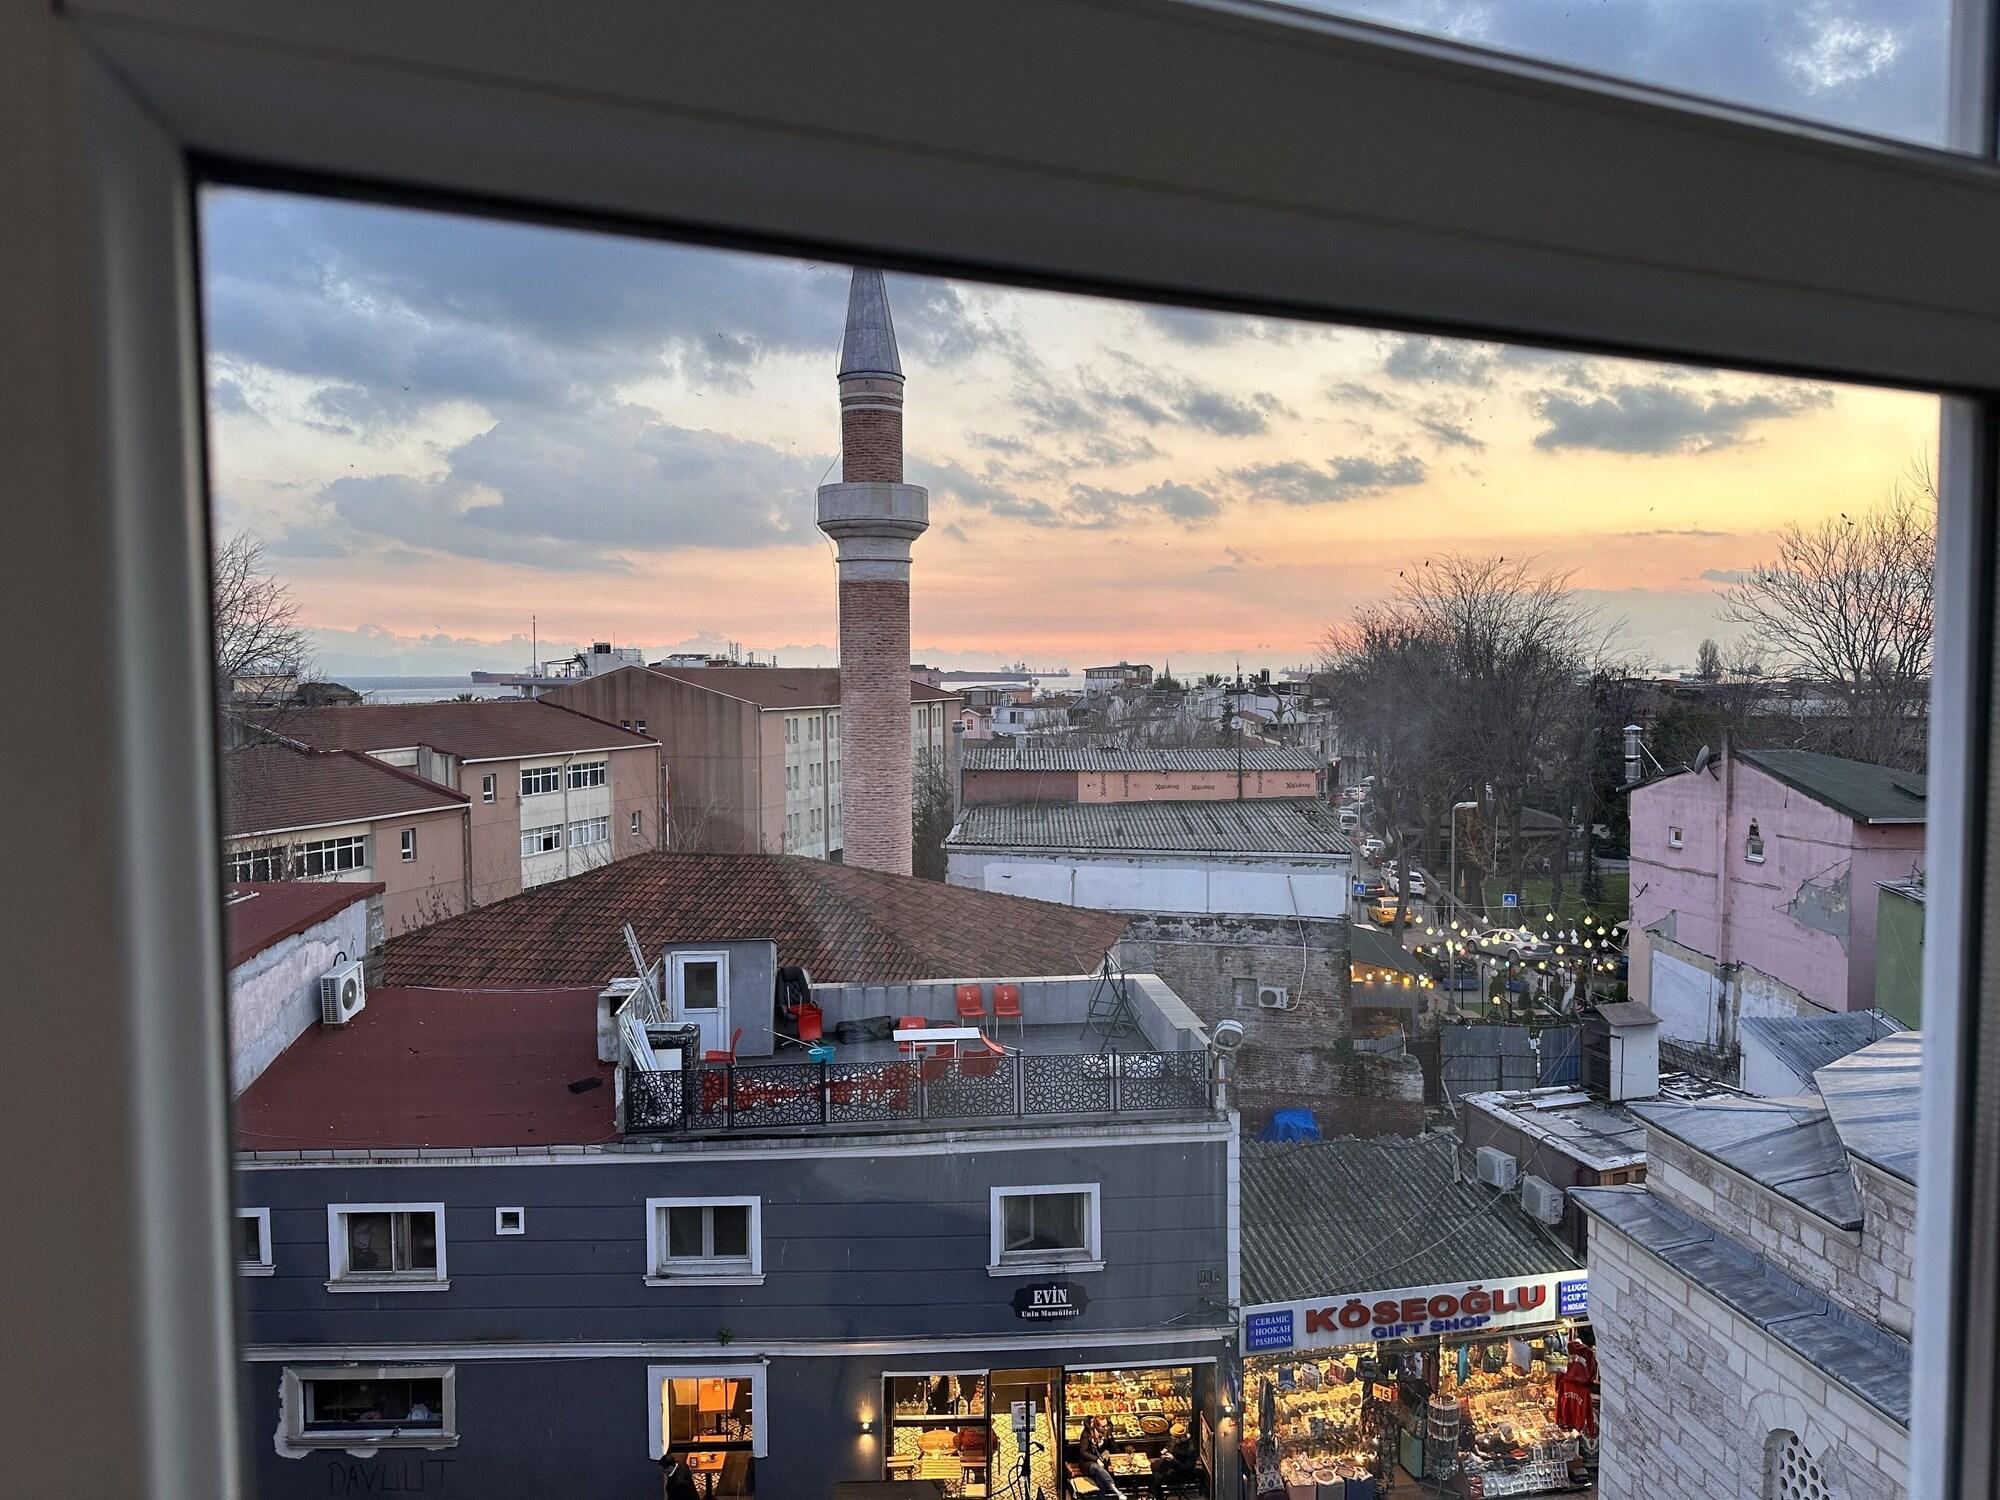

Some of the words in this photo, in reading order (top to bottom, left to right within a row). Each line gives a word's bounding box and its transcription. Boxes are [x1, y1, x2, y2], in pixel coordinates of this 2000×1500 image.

[1567, 1283, 1588, 1292] LUGG
[1033, 1285, 1067, 1304] EVİN
[1567, 1293, 1581, 1302] CUP
[1040, 1308, 1079, 1316] Mamülleri
[1306, 1284, 1546, 1333] KÖSEOĞLU
[1255, 1315, 1290, 1326] CERAMIC
[1255, 1325, 1291, 1336] HOOKAH
[1371, 1322, 1424, 1340] GIFT
[1430, 1315, 1491, 1332] SHOP
[1255, 1335, 1292, 1346] PASHMINA
[1379, 1387, 1389, 1399] 15
